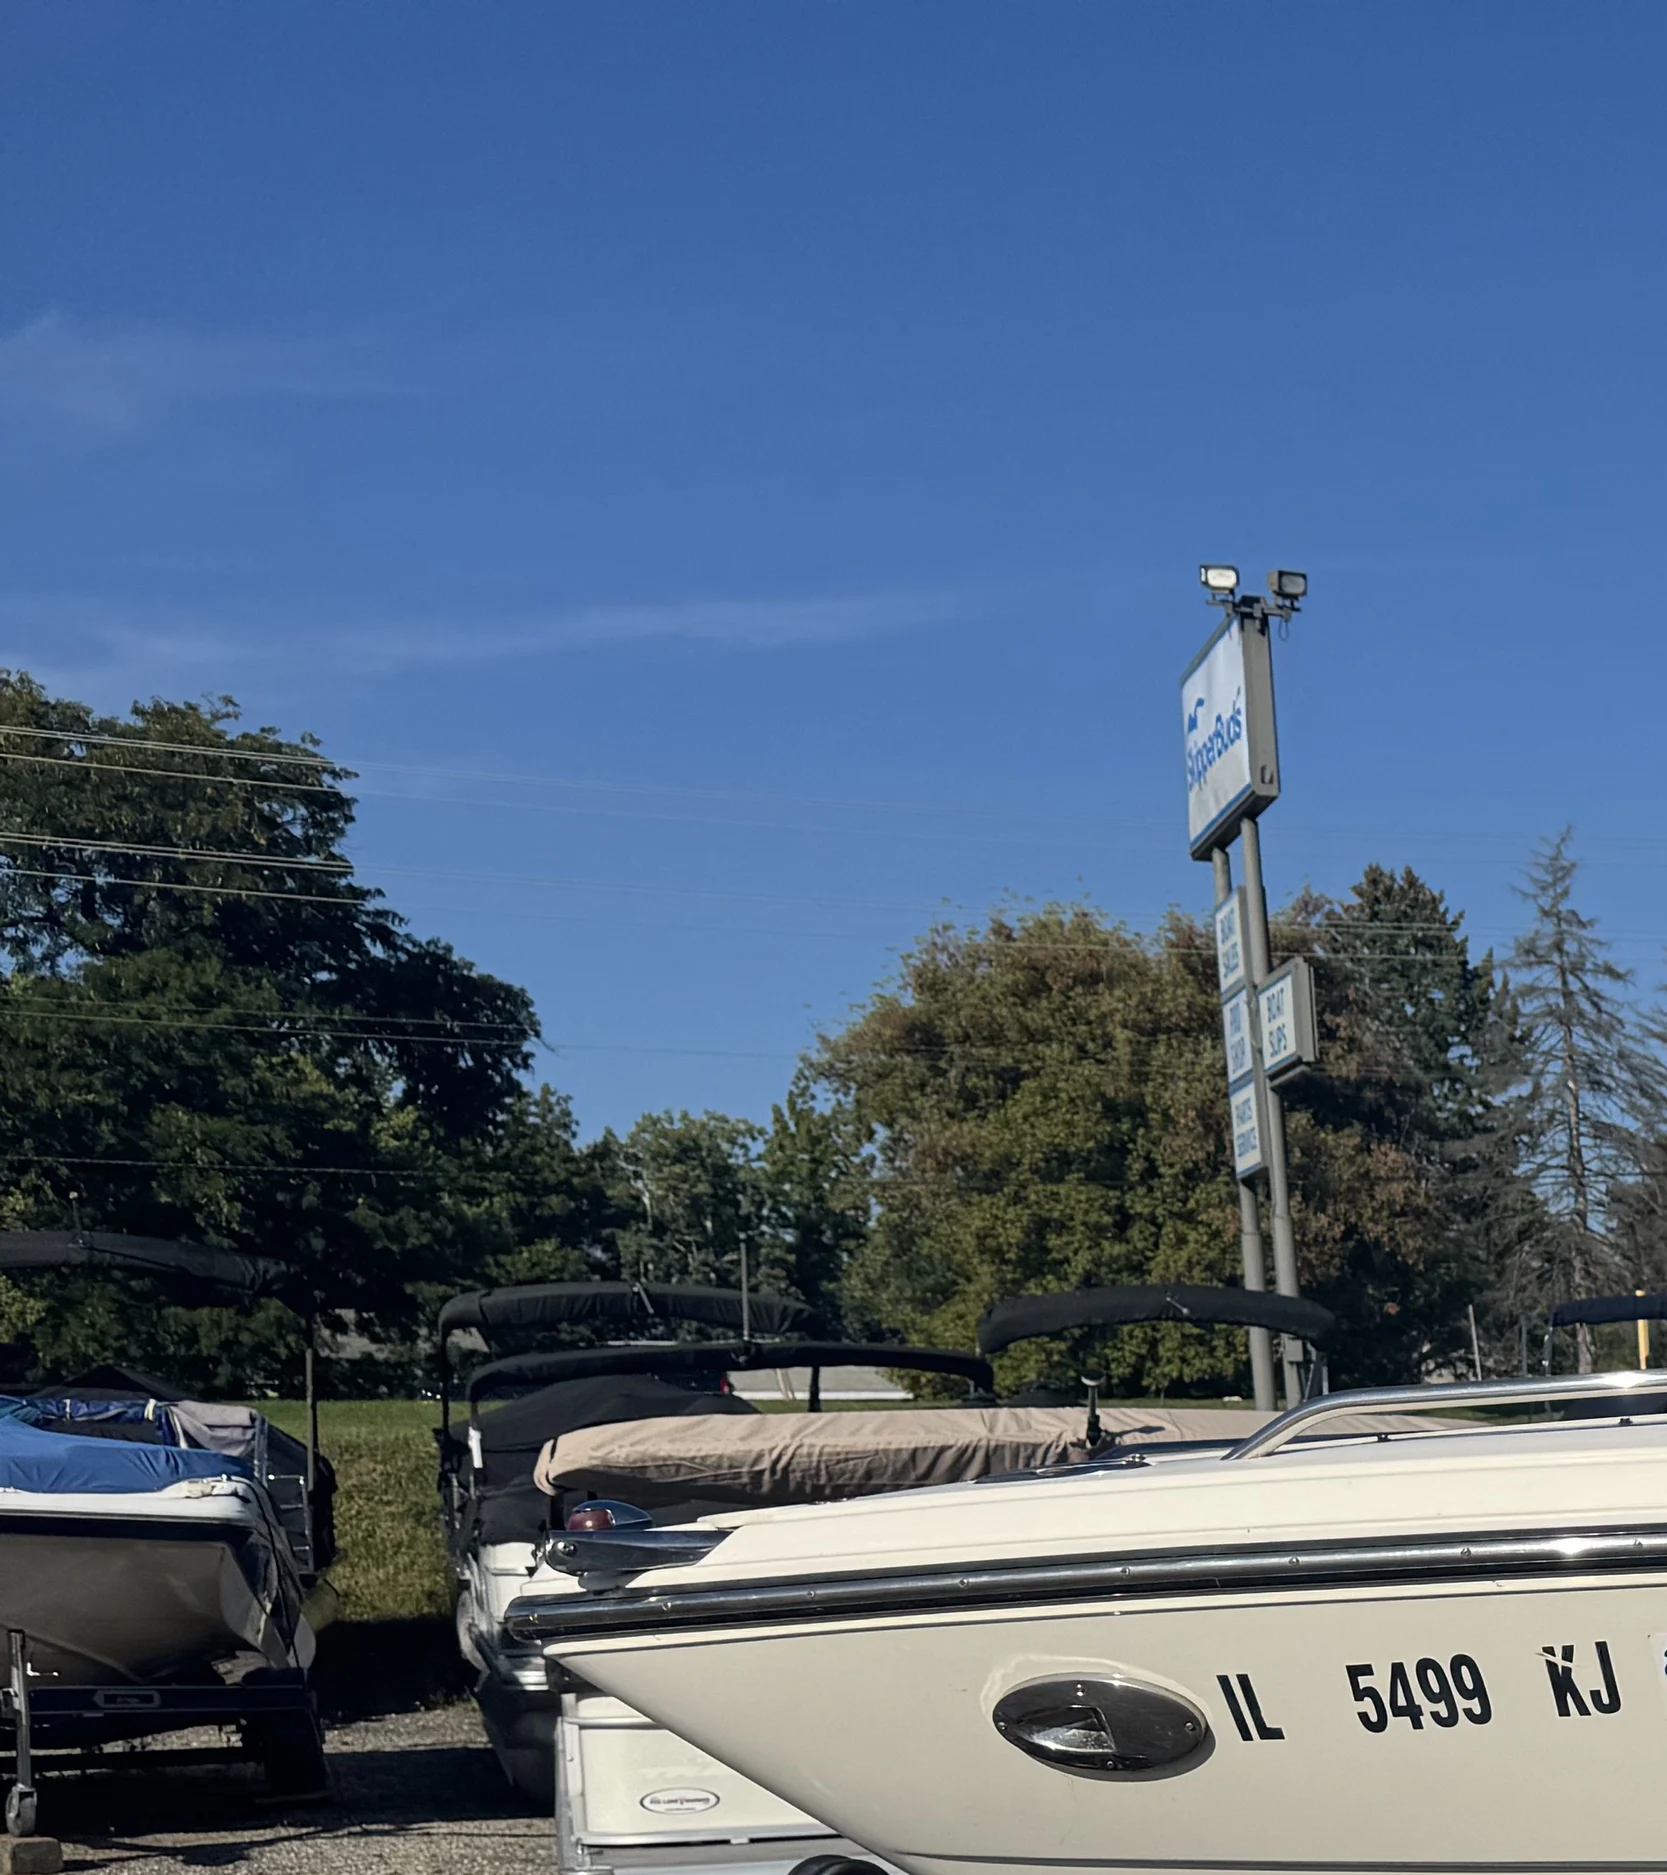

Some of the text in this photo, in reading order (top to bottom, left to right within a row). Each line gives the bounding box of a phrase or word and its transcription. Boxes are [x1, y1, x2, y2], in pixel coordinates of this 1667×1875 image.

[1266, 987, 1285, 1023] BOAT
[1268, 1023, 1287, 1058] SLIPS
[1216, 1640, 1622, 1742] IL 5499 KJ
